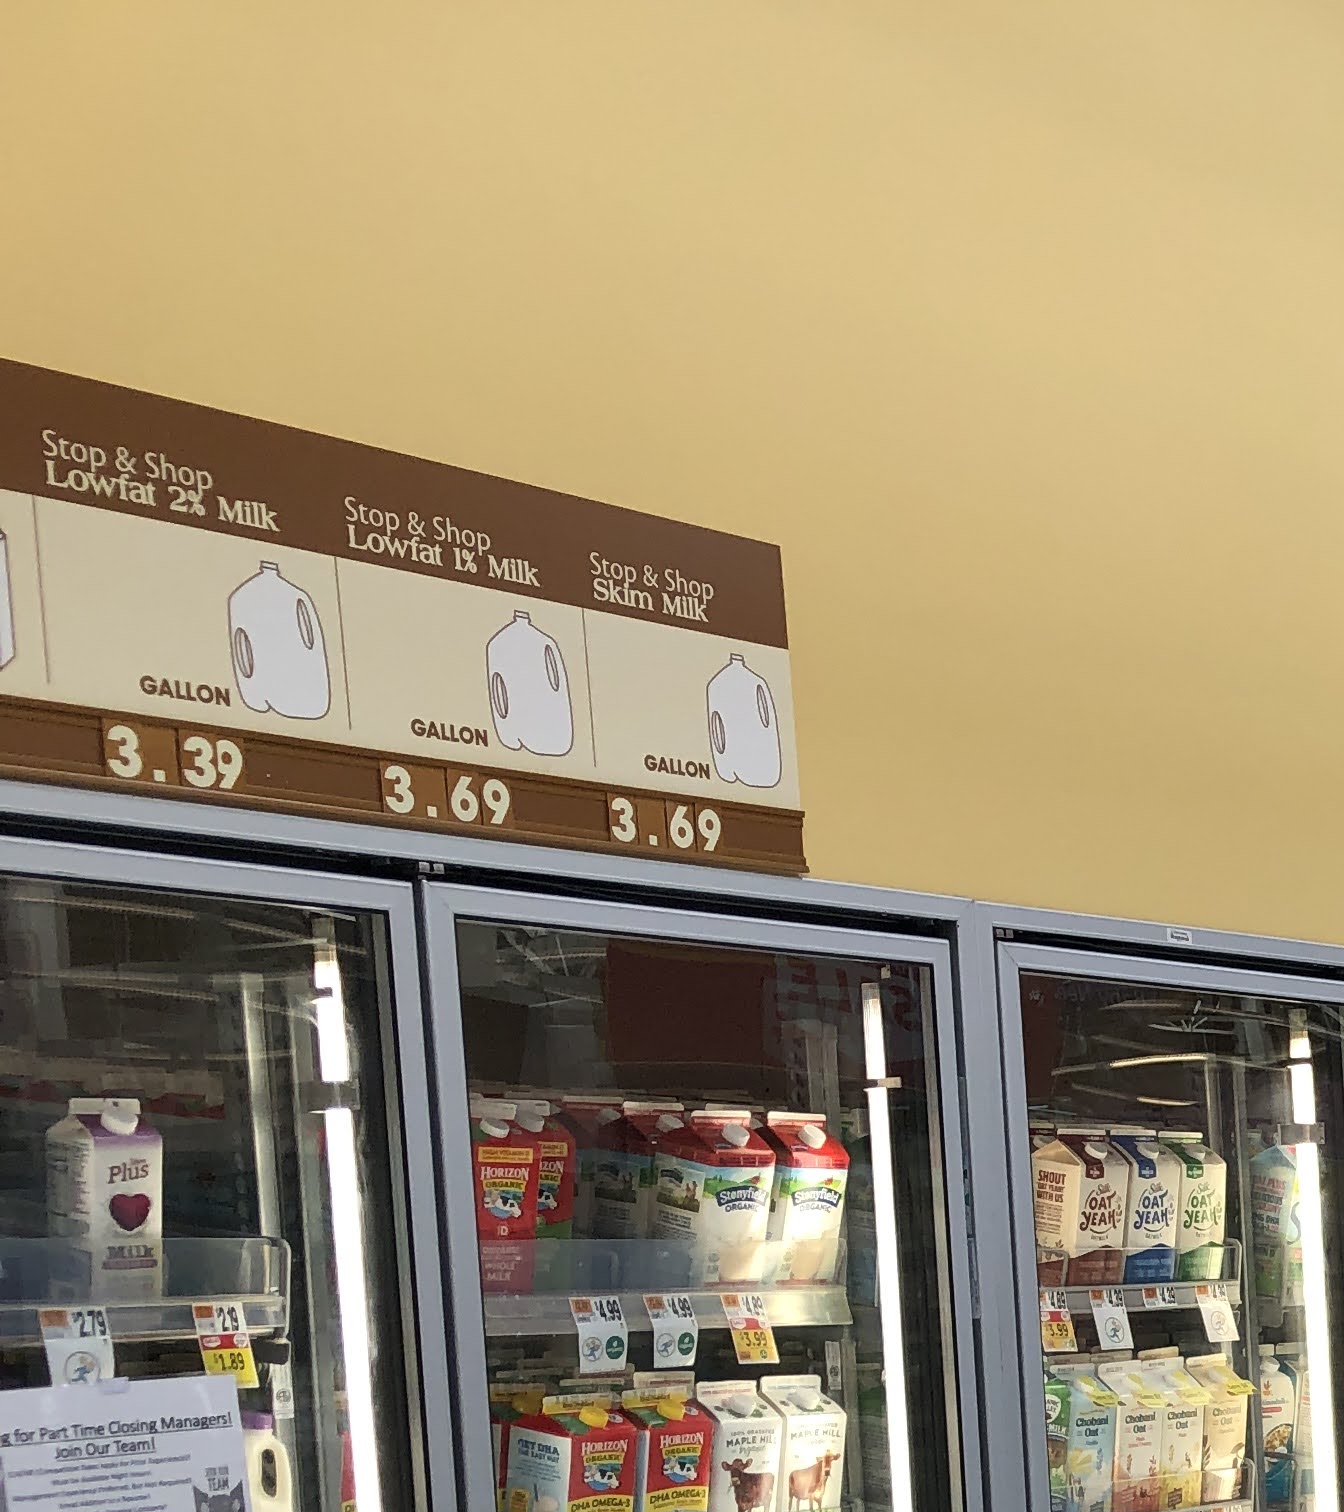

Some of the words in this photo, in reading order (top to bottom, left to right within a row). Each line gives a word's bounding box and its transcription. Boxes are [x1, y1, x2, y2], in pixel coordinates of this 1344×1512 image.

[42, 430, 105, 472] Stop
[116, 448, 136, 473] &
[145, 452, 212, 492] Shop
[45, 462, 156, 507] Lowfat
[168, 486, 206, 516] 2%
[218, 498, 280, 532] Milk
[345, 497, 398, 536] Stop
[407, 512, 425, 537] &
[433, 516, 491, 551] Shop
[347, 525, 442, 567] Lowfat
[454, 548, 478, 574] 1%
[488, 555, 539, 587] Milk
[589, 553, 635, 588] Stop
[643, 566, 659, 589] &
[665, 569, 714, 601] Shop
[593, 578, 653, 612] Skim
[662, 596, 709, 622] Milk
[139, 675, 230, 706] GALLON
[411, 719, 488, 747] GALLON
[106, 726, 242, 788] 3.39
[644, 754, 710, 779] GALLON
[384, 766, 510, 824] 3.69
[611, 799, 721, 851] 3.69
[108, 1160, 149, 1183] Plus
[480, 1167, 529, 1180] HORIZON
[1038, 1170, 1066, 1185] SHOUT
[485, 1181, 524, 1190] ORGANIC
[719, 1188, 767, 1205] Stonyfield
[791, 1188, 840, 1206] Stonyfield
[1037, 1190, 1054, 1201] WITH
[1055, 1194, 1063, 1203] US
[1088, 1191, 1116, 1210] OAT
[1142, 1189, 1169, 1210] OAT
[1190, 1189, 1216, 1209] OAT
[725, 1202, 759, 1212] ORGANIC
[1080, 1210, 1117, 1231] YEAH
[1134, 1209, 1170, 1230] YEAH
[1184, 1206, 1218, 1229] YEAH
[595, 1299, 623, 1322] $4.99
[667, 1297, 694, 1319] $4.99
[739, 1331, 767, 1347] $3.99
[213, 1352, 245, 1375] $1.89
[1076, 1415, 1109, 1427] Chobani
[1125, 1412, 1155, 1424] Chobani
[1168, 1409, 1197, 1420] Chobani
[14, 1429, 34, 1443] for
[40, 1427, 67, 1440] Part
[71, 1424, 105, 1438] Time
[109, 1420, 157, 1435] Closing
[161, 1412, 232, 1429] Managers!
[822, 1427, 841, 1438] HILL
[1085, 1427, 1099, 1437] Oat
[1133, 1425, 1146, 1433] Oat
[1176, 1420, 1188, 1429] Oat
[55, 1444, 82, 1459] Join
[86, 1443, 109, 1456] Our
[113, 1437, 156, 1453] Team!
[581, 1439, 628, 1456] HORIZON
[660, 1432, 704, 1448] HORIZON
[726, 1436, 757, 1447] MAPLE
[538, 1443, 559, 1456] DHA
[664, 1447, 699, 1456] ORGANIC
[586, 1454, 621, 1464] ORGANIC
[208, 1477, 229, 1491] TEAM
[571, 1498, 590, 1512] DHA
[592, 1497, 630, 1507] OMEGA-3
[650, 1491, 670, 1504] DHA
